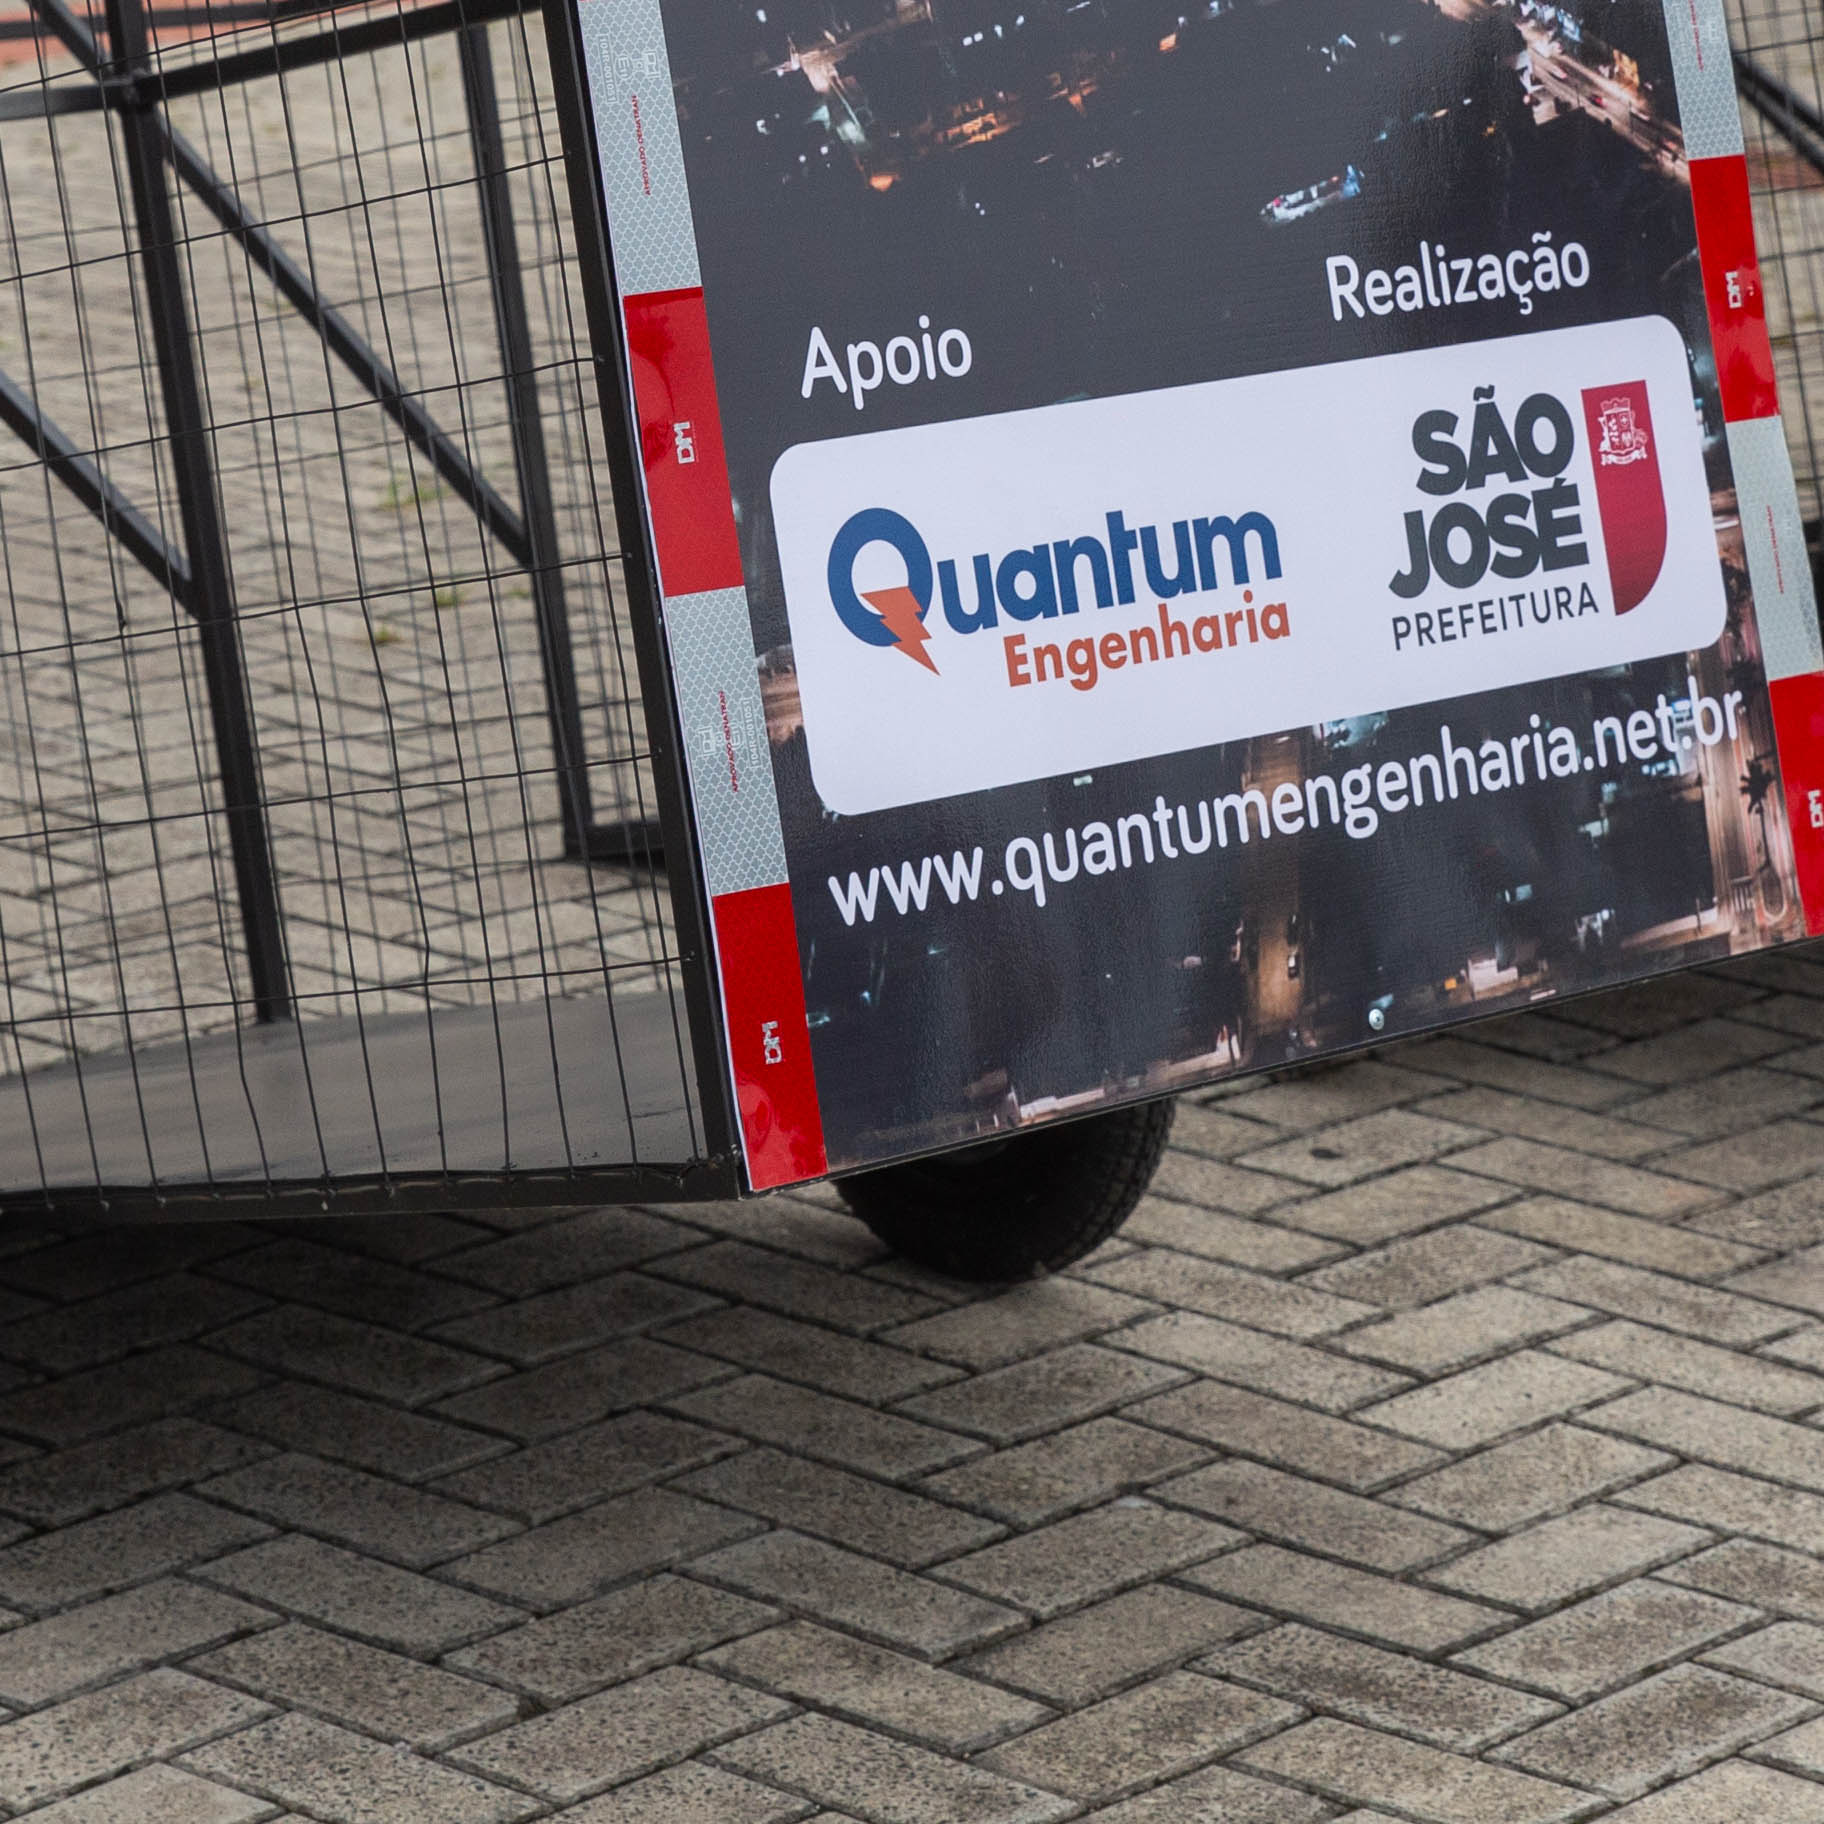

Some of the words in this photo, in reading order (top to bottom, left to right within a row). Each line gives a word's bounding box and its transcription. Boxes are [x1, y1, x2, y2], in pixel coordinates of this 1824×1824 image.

[1326, 232, 1590, 320] Realização
[1726, 271, 1741, 308] DM
[802, 315, 971, 410] Apoio
[674, 422, 694, 464] DM
[1412, 385, 1574, 495] SÃO
[1389, 479, 1589, 599] JOSÉ
[828, 508, 1283, 675] Quantum
[1392, 582, 1598, 650] PREFEITURA
[1004, 590, 1289, 690] Engenharia
[828, 675, 1742, 926] www.quantumengenharia.net.br
[1808, 790, 1824, 827] DM
[762, 1021, 781, 1064] DM
